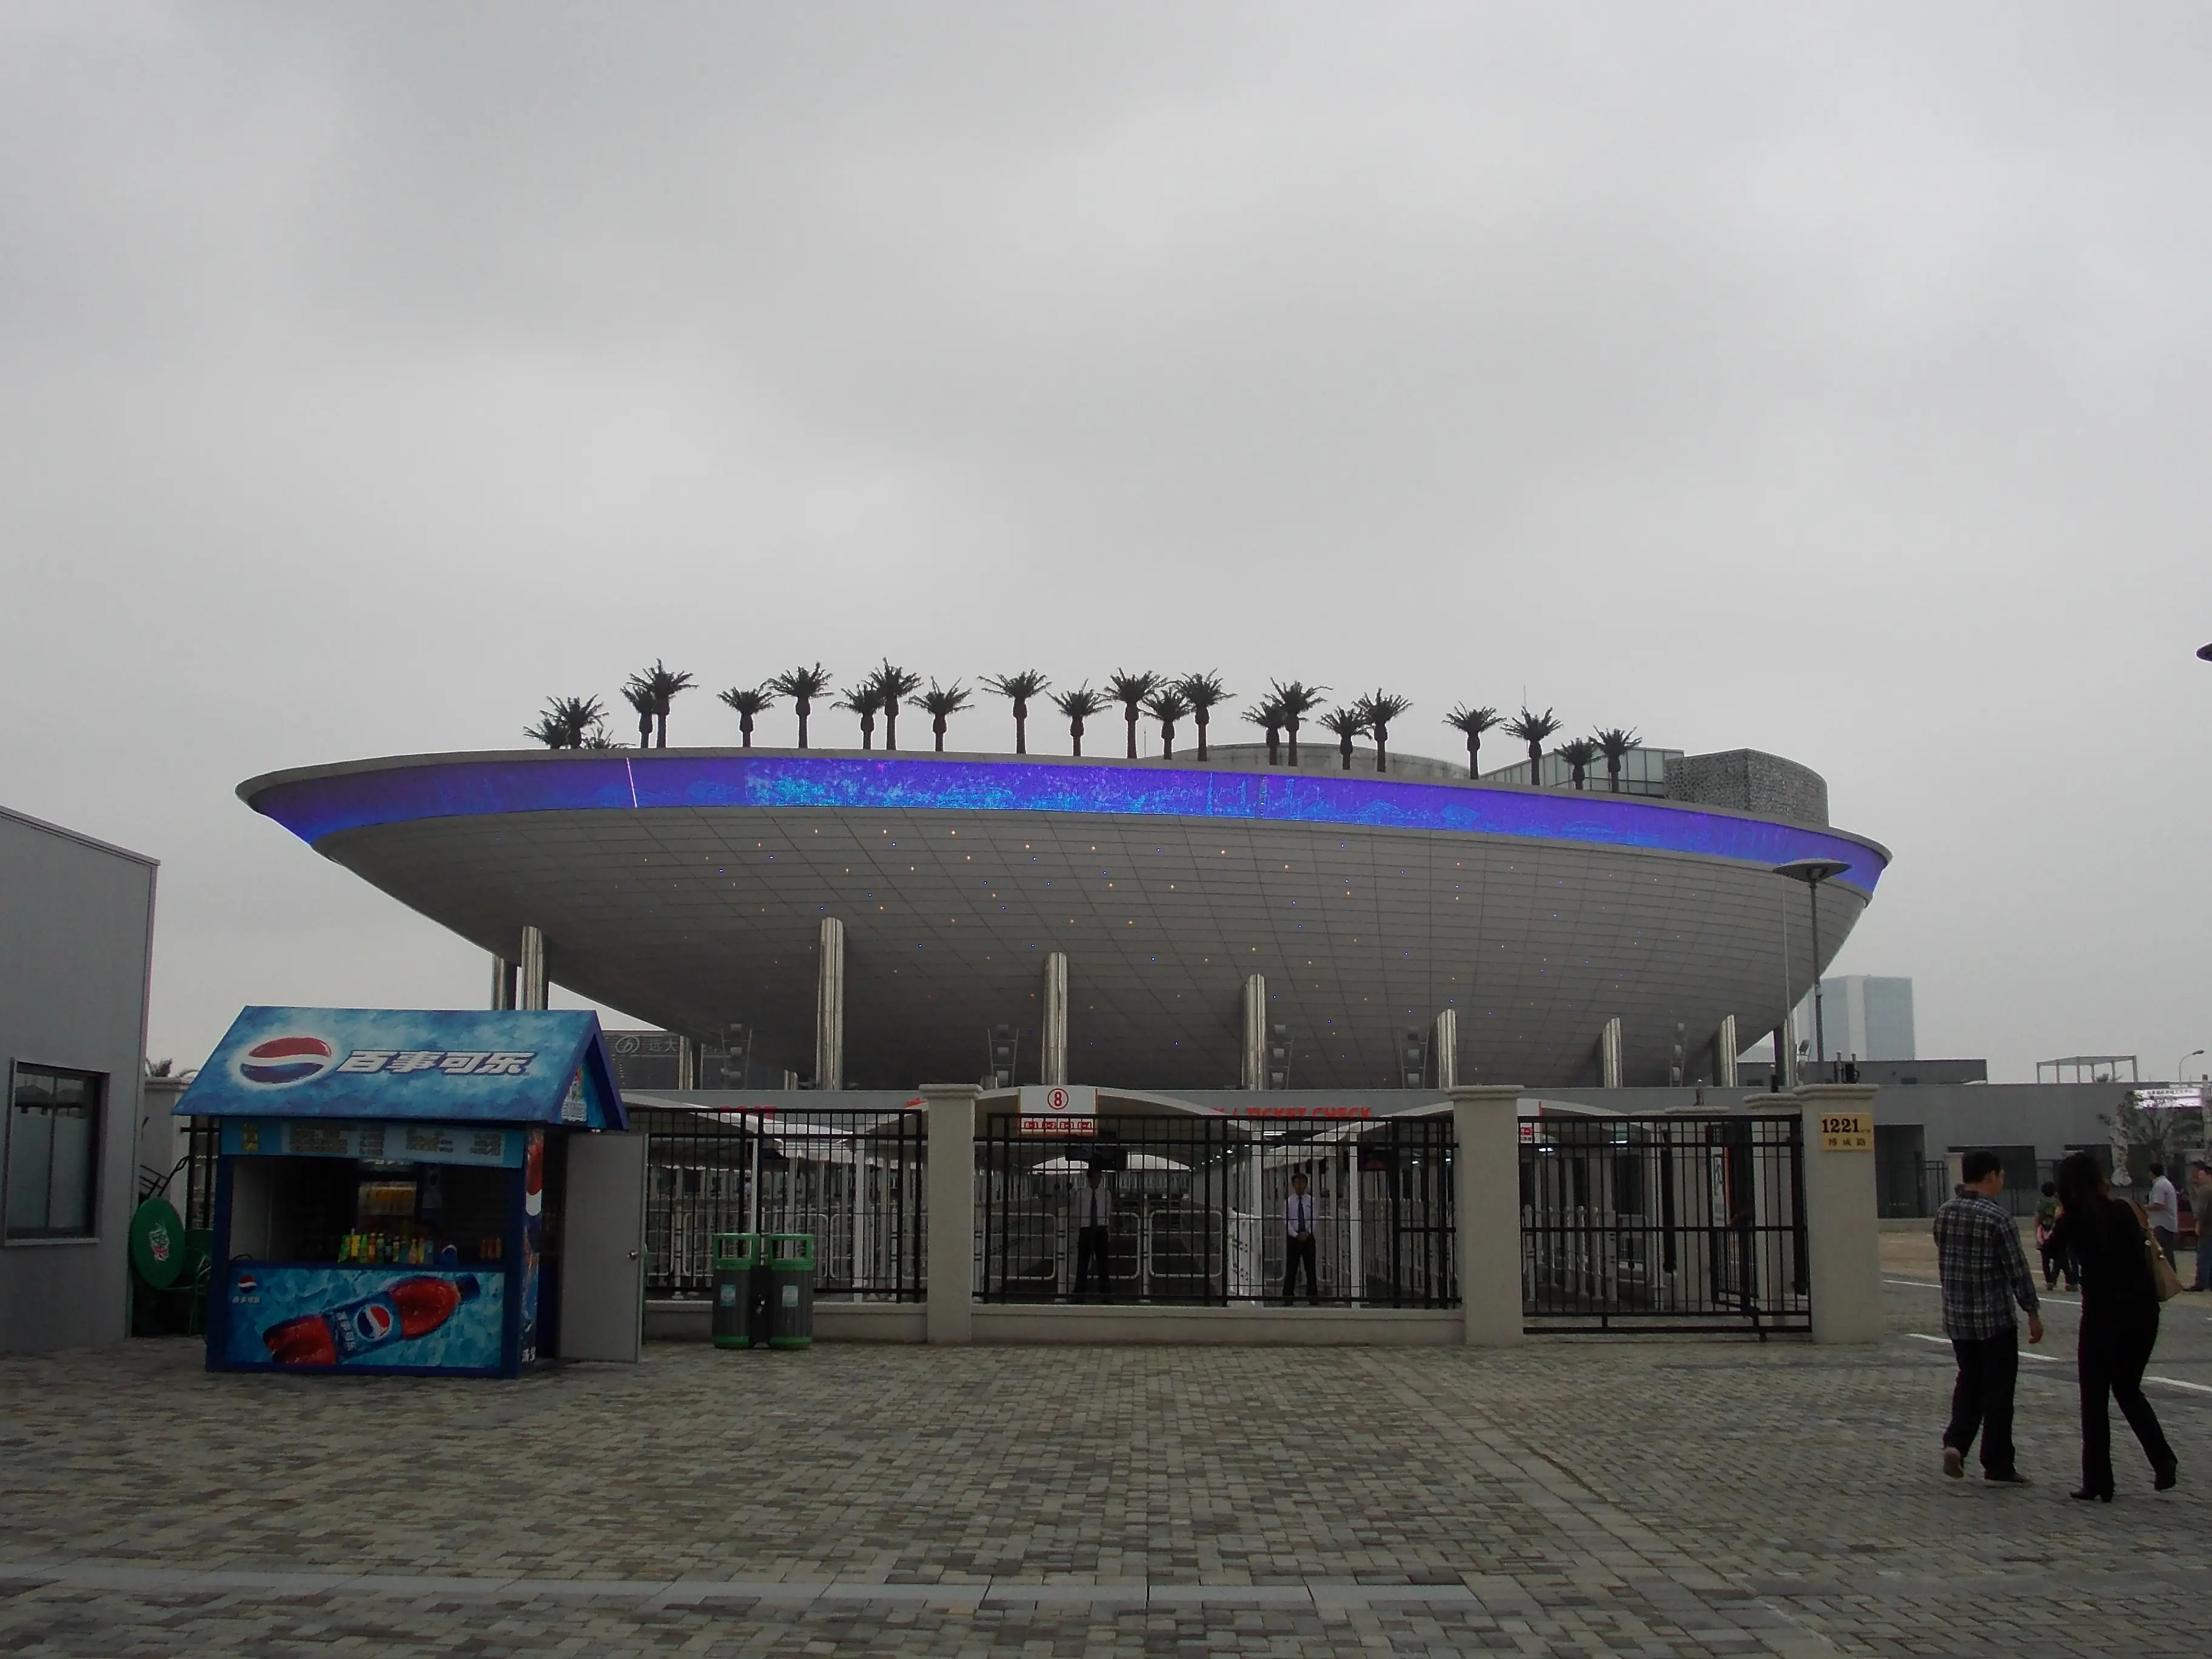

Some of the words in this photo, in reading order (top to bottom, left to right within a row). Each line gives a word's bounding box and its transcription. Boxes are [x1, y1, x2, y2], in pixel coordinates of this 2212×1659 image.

[335, 1050, 537, 1074] 百事可乐
[1054, 1091, 1062, 1107] 8
[1245, 1107, 1307, 1117] TICKET
[1312, 1107, 1373, 1118] CHECK
[1822, 1118, 1859, 1133] 1221
